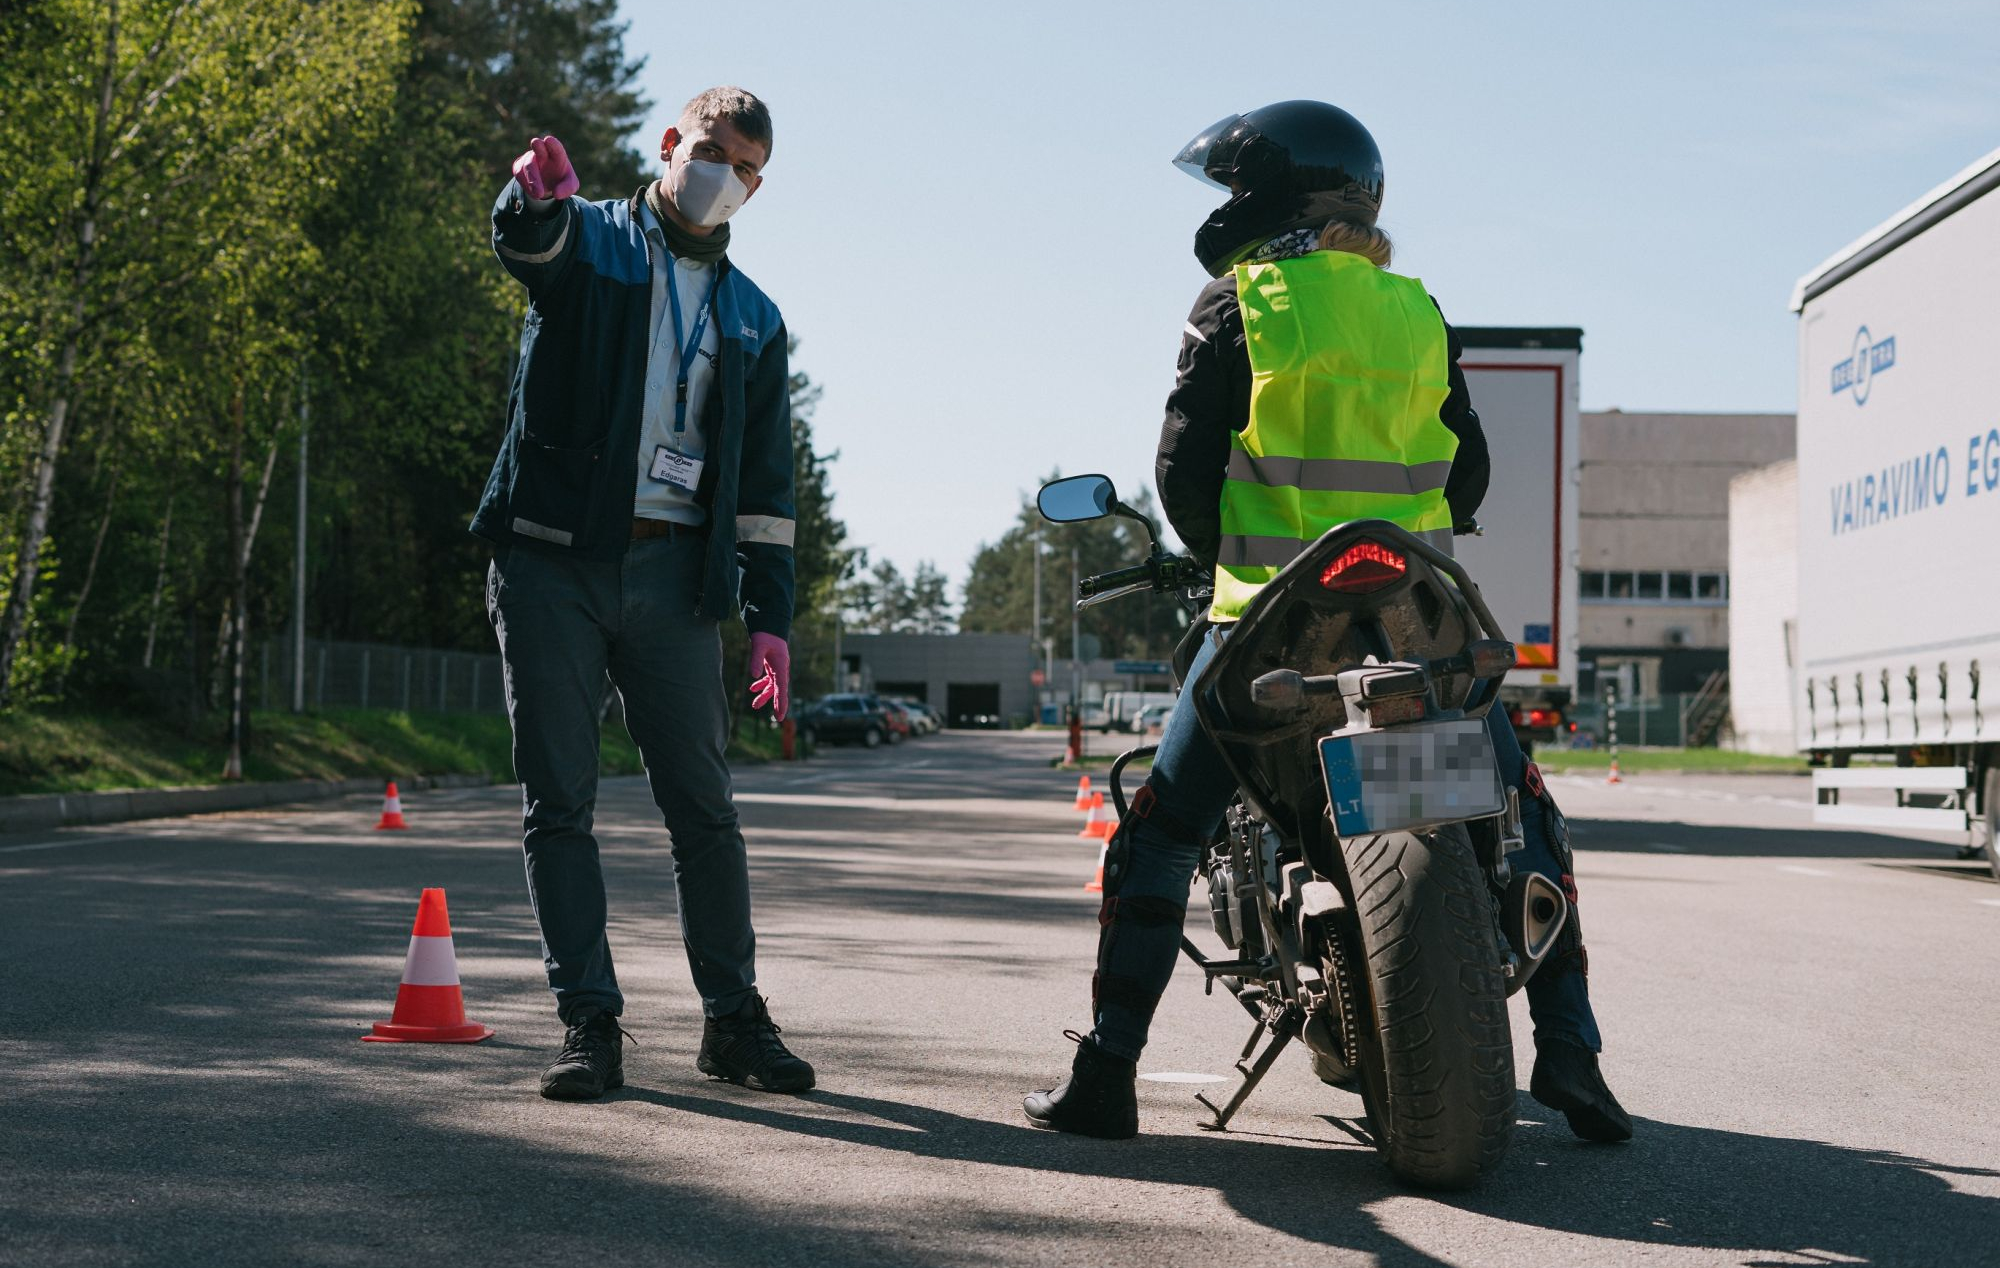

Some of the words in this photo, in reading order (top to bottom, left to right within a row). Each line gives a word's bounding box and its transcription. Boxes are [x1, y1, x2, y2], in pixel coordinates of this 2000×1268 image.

[660, 470, 687, 484] Edgaras
[1830, 446, 1949, 536] VAIRAVIMO
[1966, 428, 2000, 497] EG
[1336, 799, 1360, 815] LT
